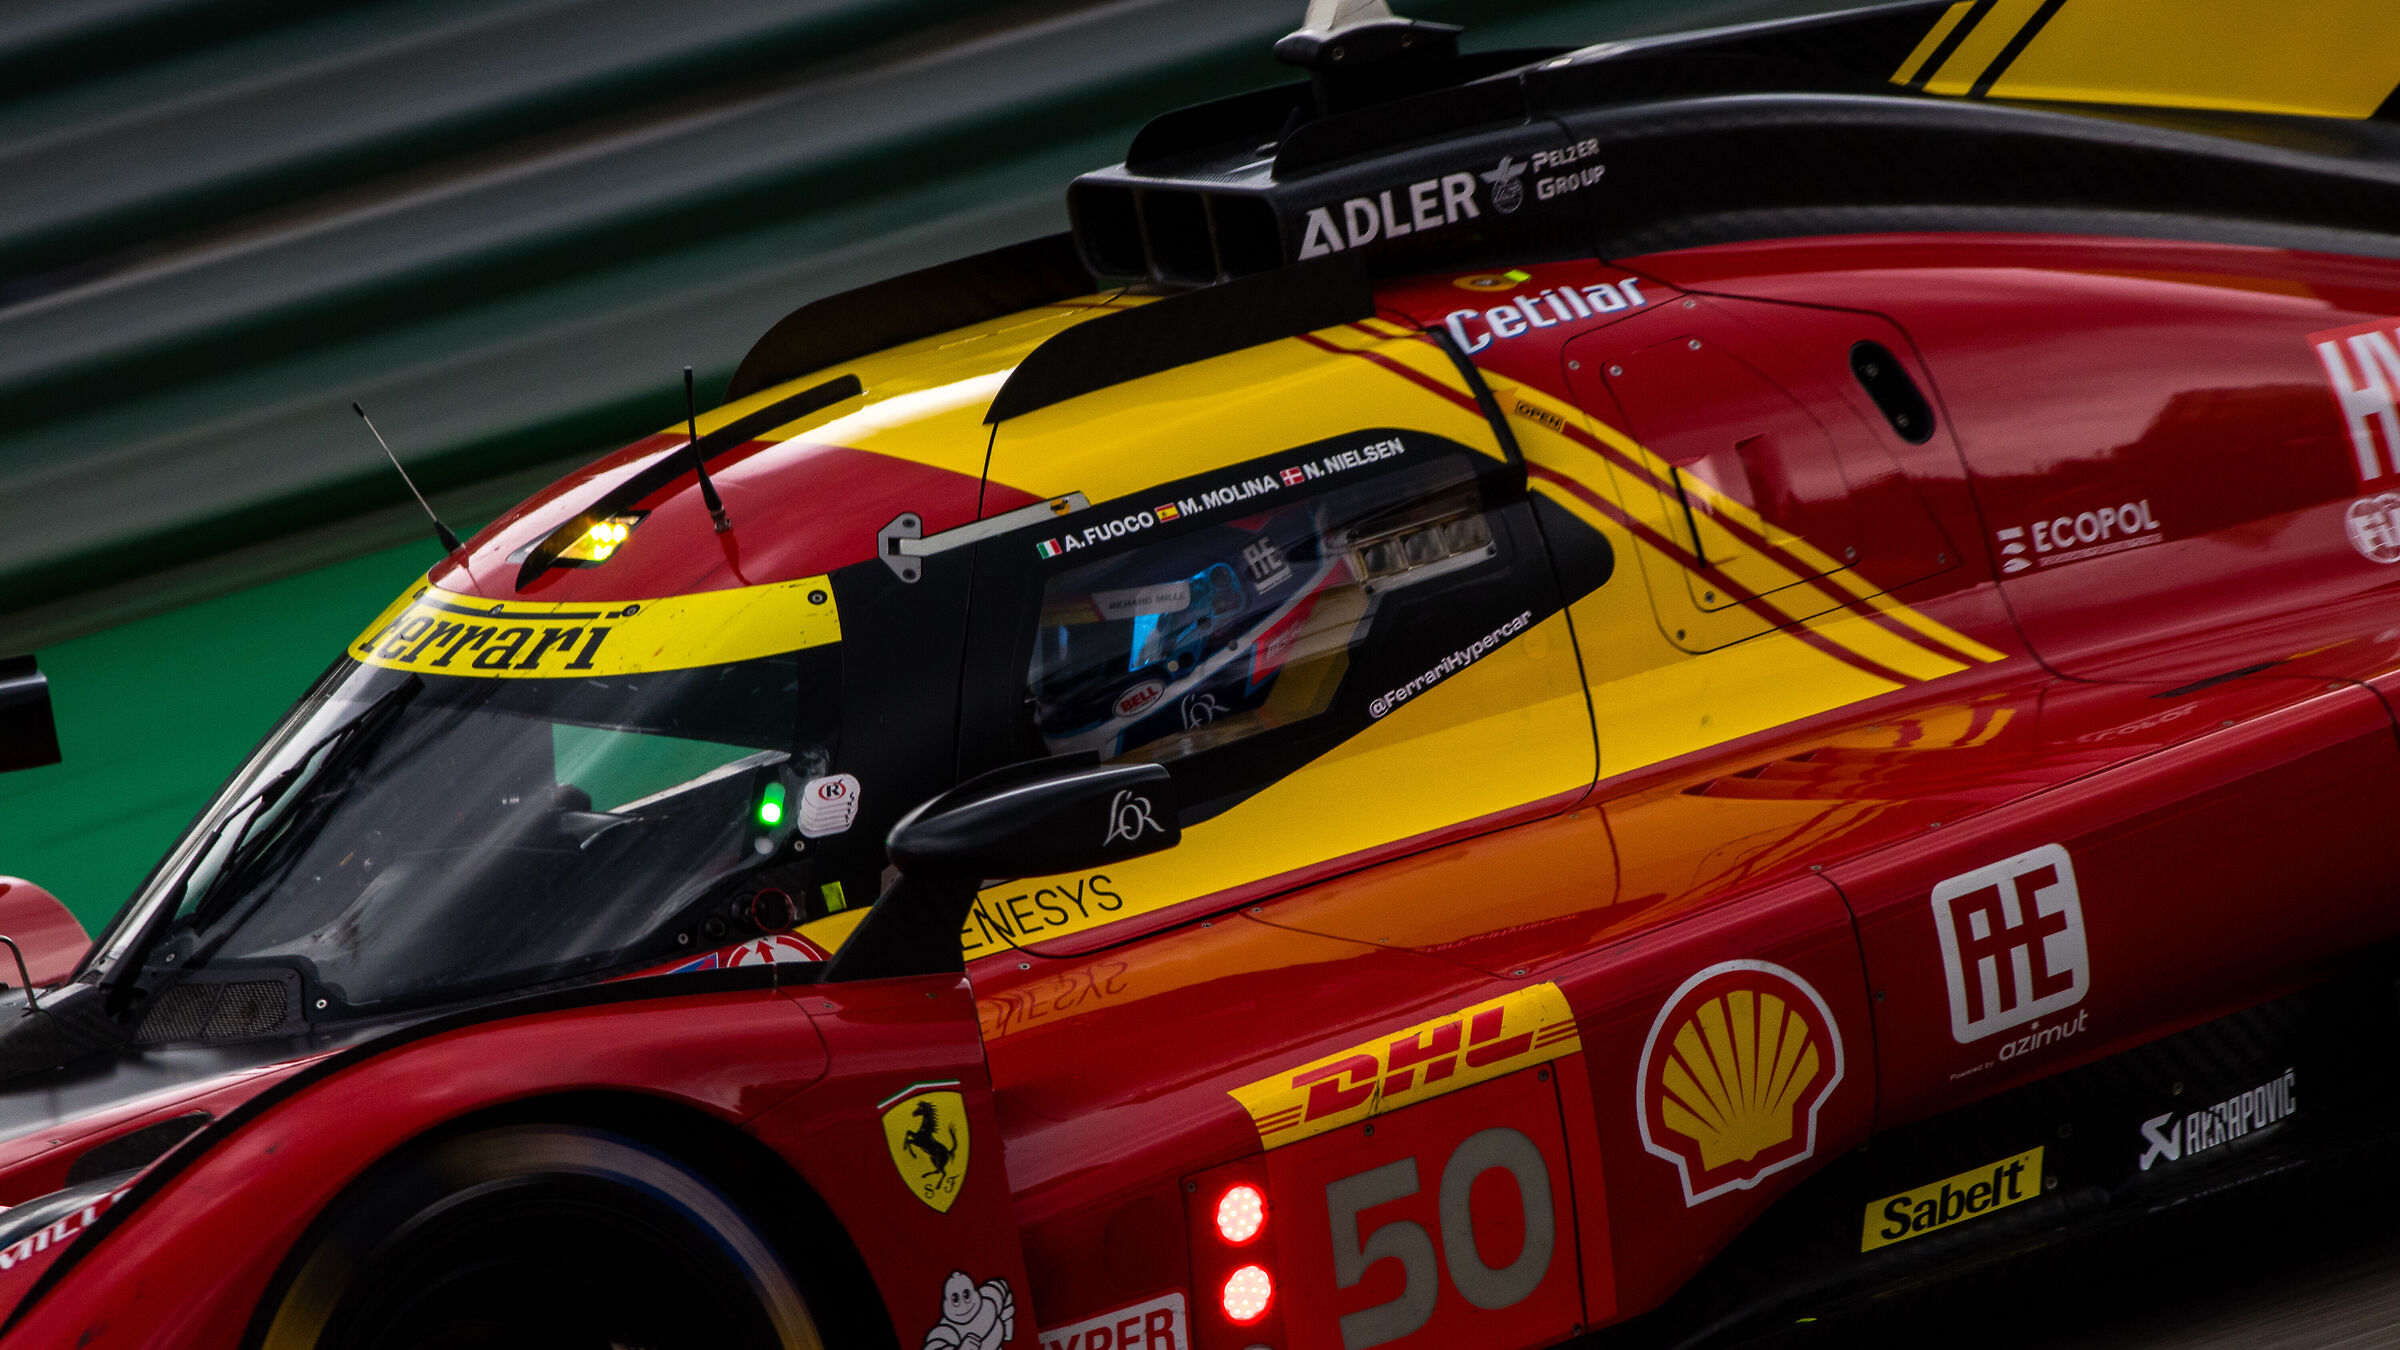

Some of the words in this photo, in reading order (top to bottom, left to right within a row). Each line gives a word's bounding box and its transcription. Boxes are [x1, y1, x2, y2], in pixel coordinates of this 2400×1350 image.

[1531, 138, 1600, 174] PELZER
[1536, 164, 1606, 200] GROUP
[1298, 171, 1480, 261] ADLER
[1445, 276, 1647, 356] Cetilar
[1517, 403, 1563, 429] OPEN
[1083, 511, 1154, 546] FUOCO
[1201, 473, 1280, 510] MOLINA
[1323, 437, 1405, 474] NIELSEN
[2031, 499, 2161, 553] ECOPOL
[1120, 685, 1160, 714] BELL
[1369, 609, 1532, 719] @FerrariHypercar
[1291, 1005, 1535, 1123] DHL
[1999, 1009, 2089, 1061] azimut
[1325, 1126, 1557, 1350] 50
[1881, 1159, 2025, 1240] Sabelt
